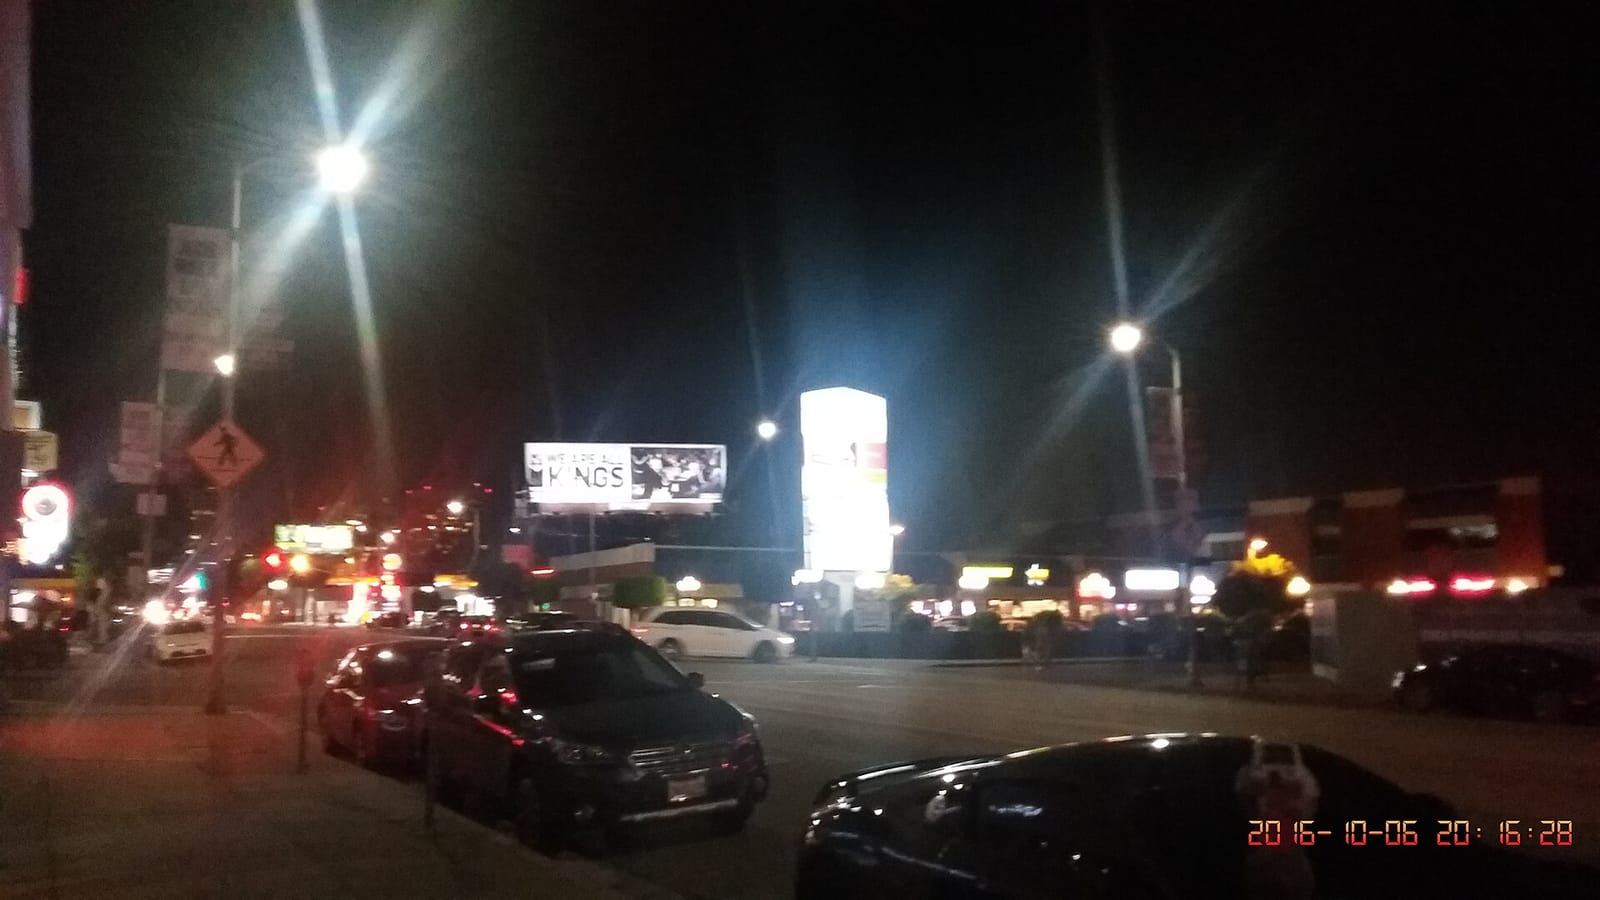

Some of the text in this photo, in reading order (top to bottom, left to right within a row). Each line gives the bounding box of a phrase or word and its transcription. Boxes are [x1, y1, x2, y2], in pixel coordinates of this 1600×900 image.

[547, 453, 625, 466] WE ARE ALL
[548, 466, 624, 489] KNGS
